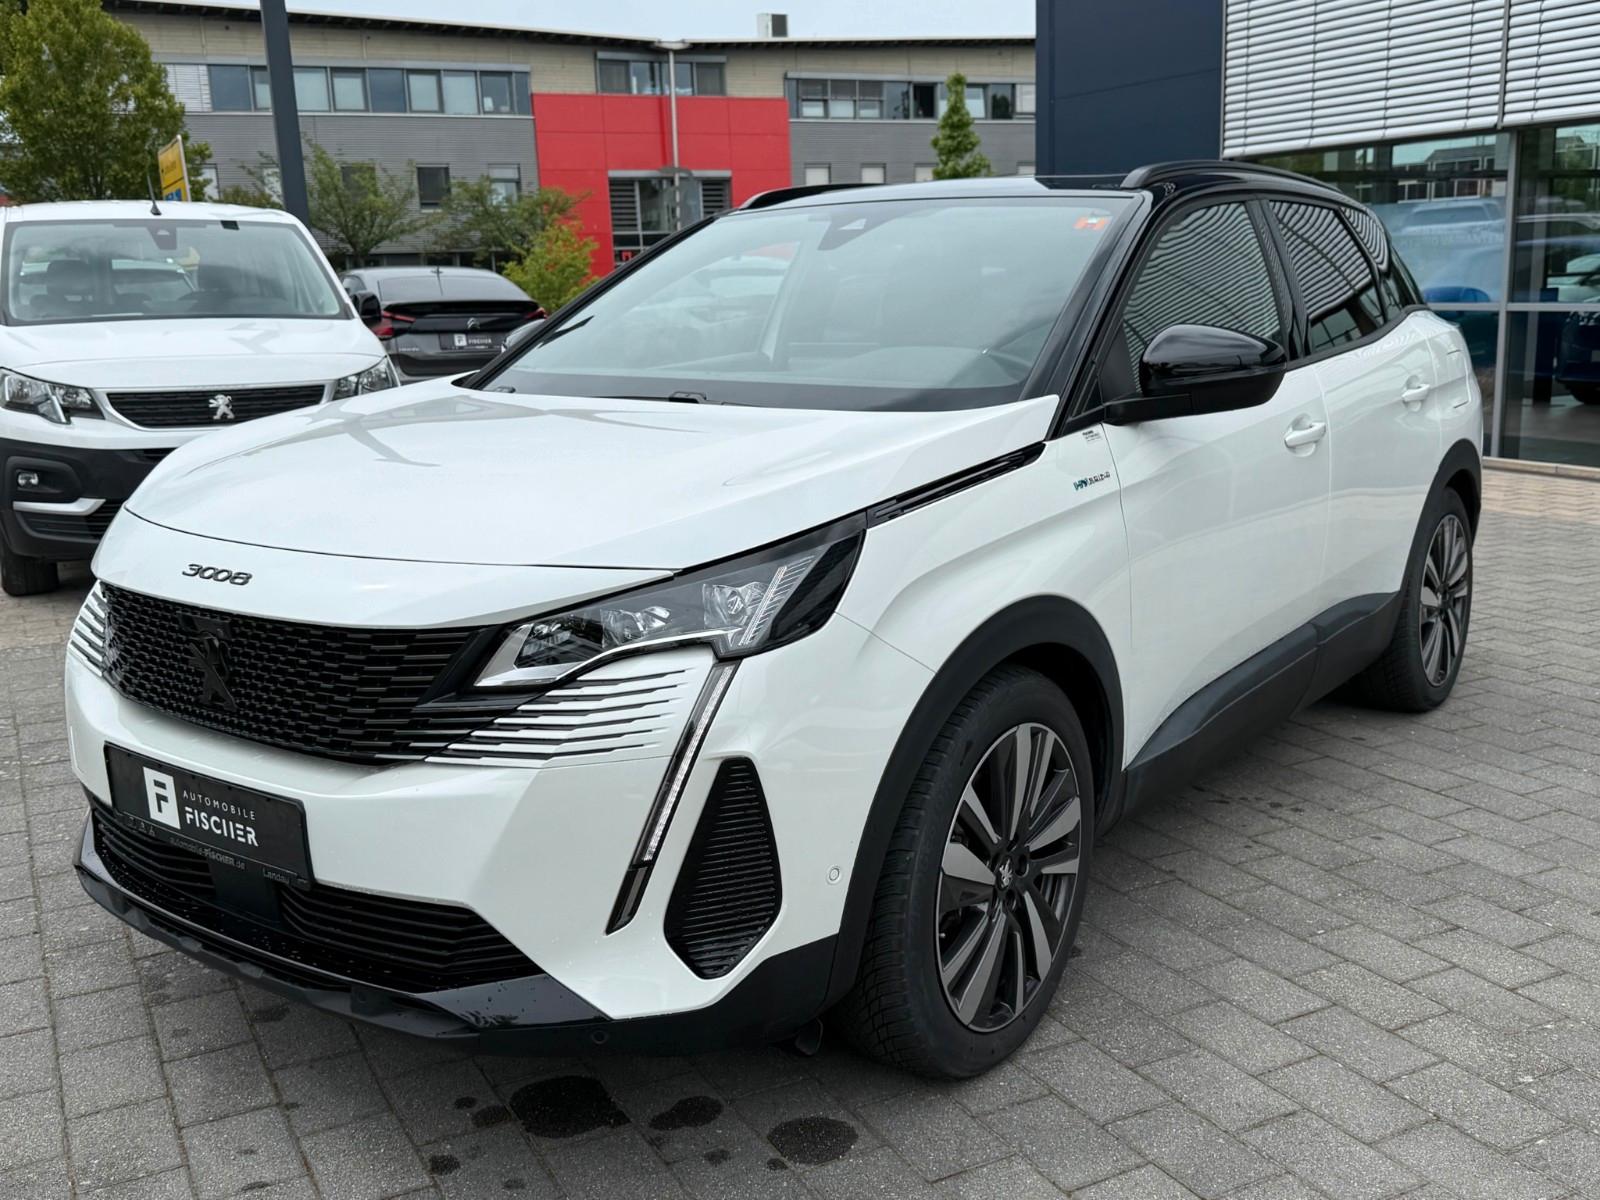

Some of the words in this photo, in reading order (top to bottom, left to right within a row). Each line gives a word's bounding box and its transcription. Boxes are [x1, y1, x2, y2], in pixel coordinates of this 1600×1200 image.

[181, 563, 253, 586] 3008
[182, 789, 256, 820] AUTOMOBILE
[184, 806, 259, 847] FISCHER
